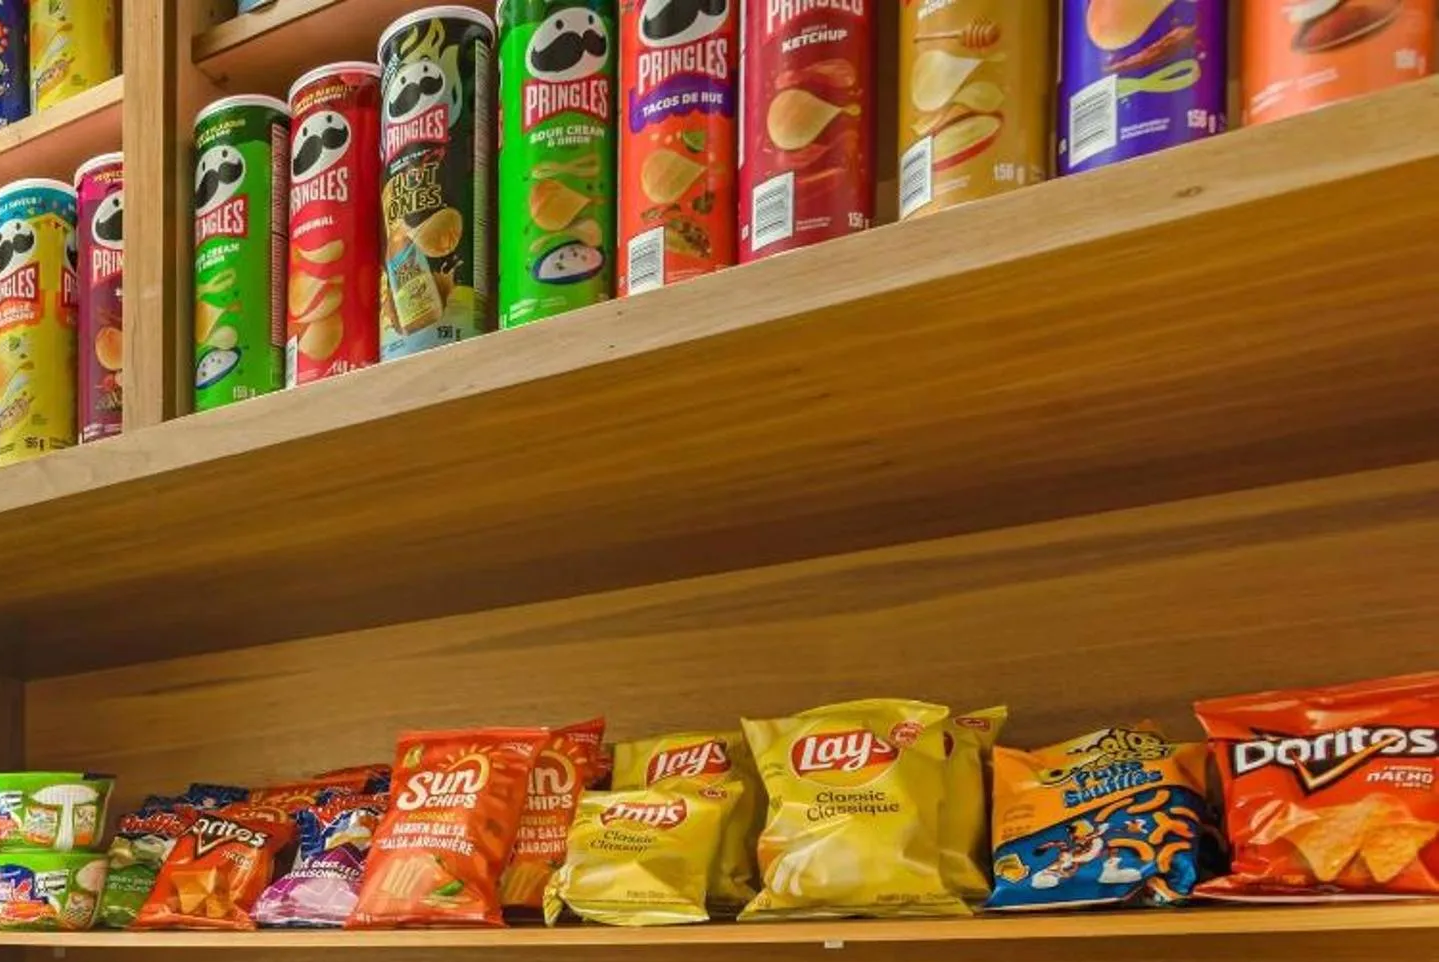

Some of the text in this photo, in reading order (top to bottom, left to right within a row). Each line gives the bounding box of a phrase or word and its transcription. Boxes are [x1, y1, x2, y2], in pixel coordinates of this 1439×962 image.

[782, 29, 848, 53] KETCHUP
[639, 39, 727, 93] PRINGLES
[526, 79, 608, 128] PRINGLES
[643, 92, 724, 117] TACOS DE RUE
[387, 109, 444, 151] PRINGLES
[531, 125, 605, 145] SOUR CREAM
[393, 164, 439, 199] HOT
[388, 187, 445, 219] ONES
[800, 729, 893, 771] Lay's
[1235, 726, 1438, 776] Doritos
[397, 770, 488, 810] Sun
[426, 794, 477, 809] CHIPS
[529, 795, 573, 812] HIPS
[816, 791, 885, 806] Classic
[807, 800, 900, 822] Classique
